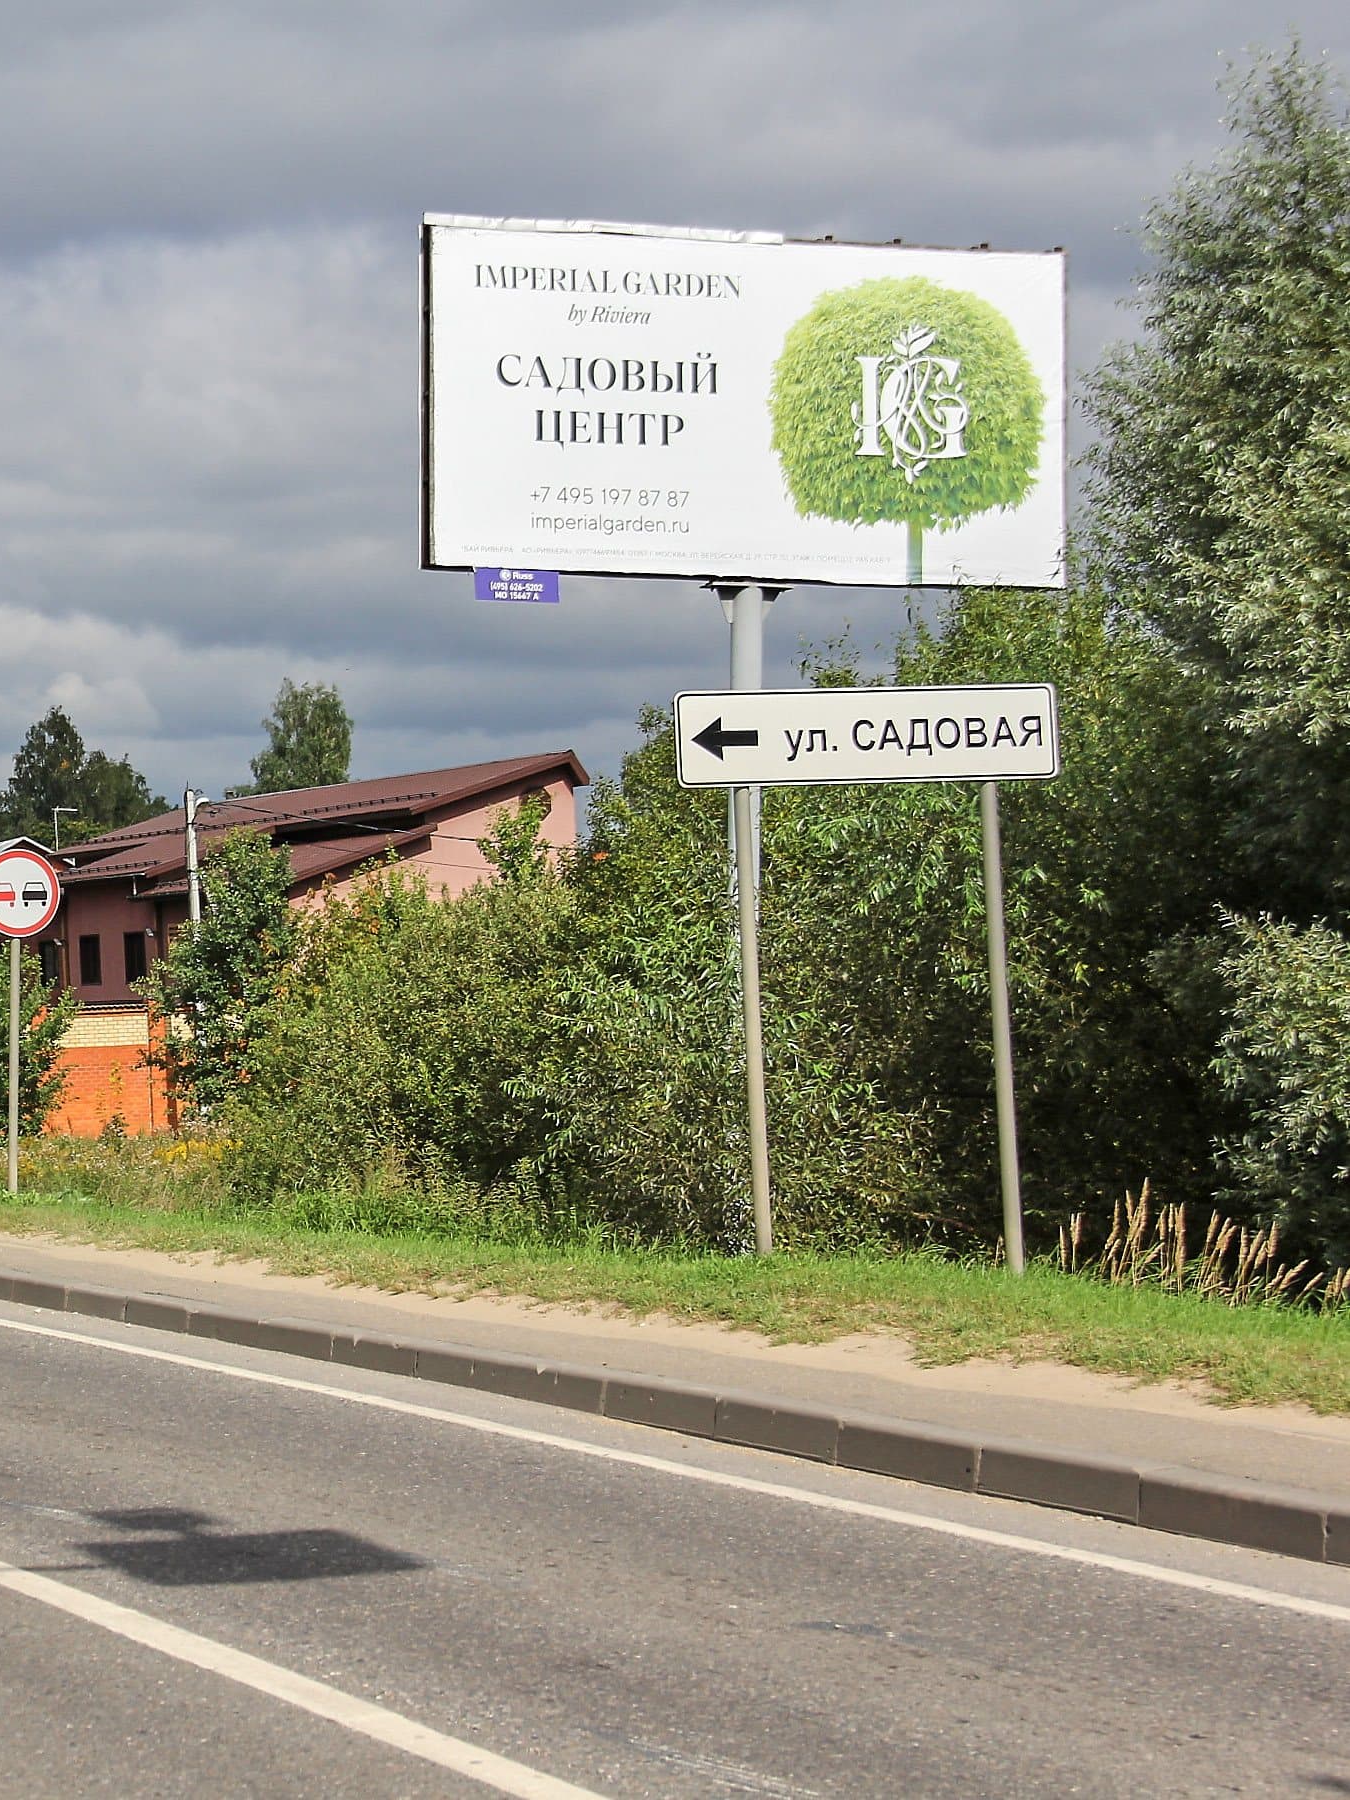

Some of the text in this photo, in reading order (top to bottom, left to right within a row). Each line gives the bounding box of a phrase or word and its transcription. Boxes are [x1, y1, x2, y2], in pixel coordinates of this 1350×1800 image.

[474, 264, 741, 299] IMPERIAL GARDEN
[568, 304, 651, 326] by Riviera
[496, 352, 718, 398] САДОВЫЙ
[535, 410, 685, 451] ЦЕНТР
[530, 487, 690, 508] +7 495 197 87 87
[530, 512, 690, 535] imperialgarden.ru
[490, 582, 508, 591] (495)
[785, 716, 1043, 762] ул. САДОВАЯ
